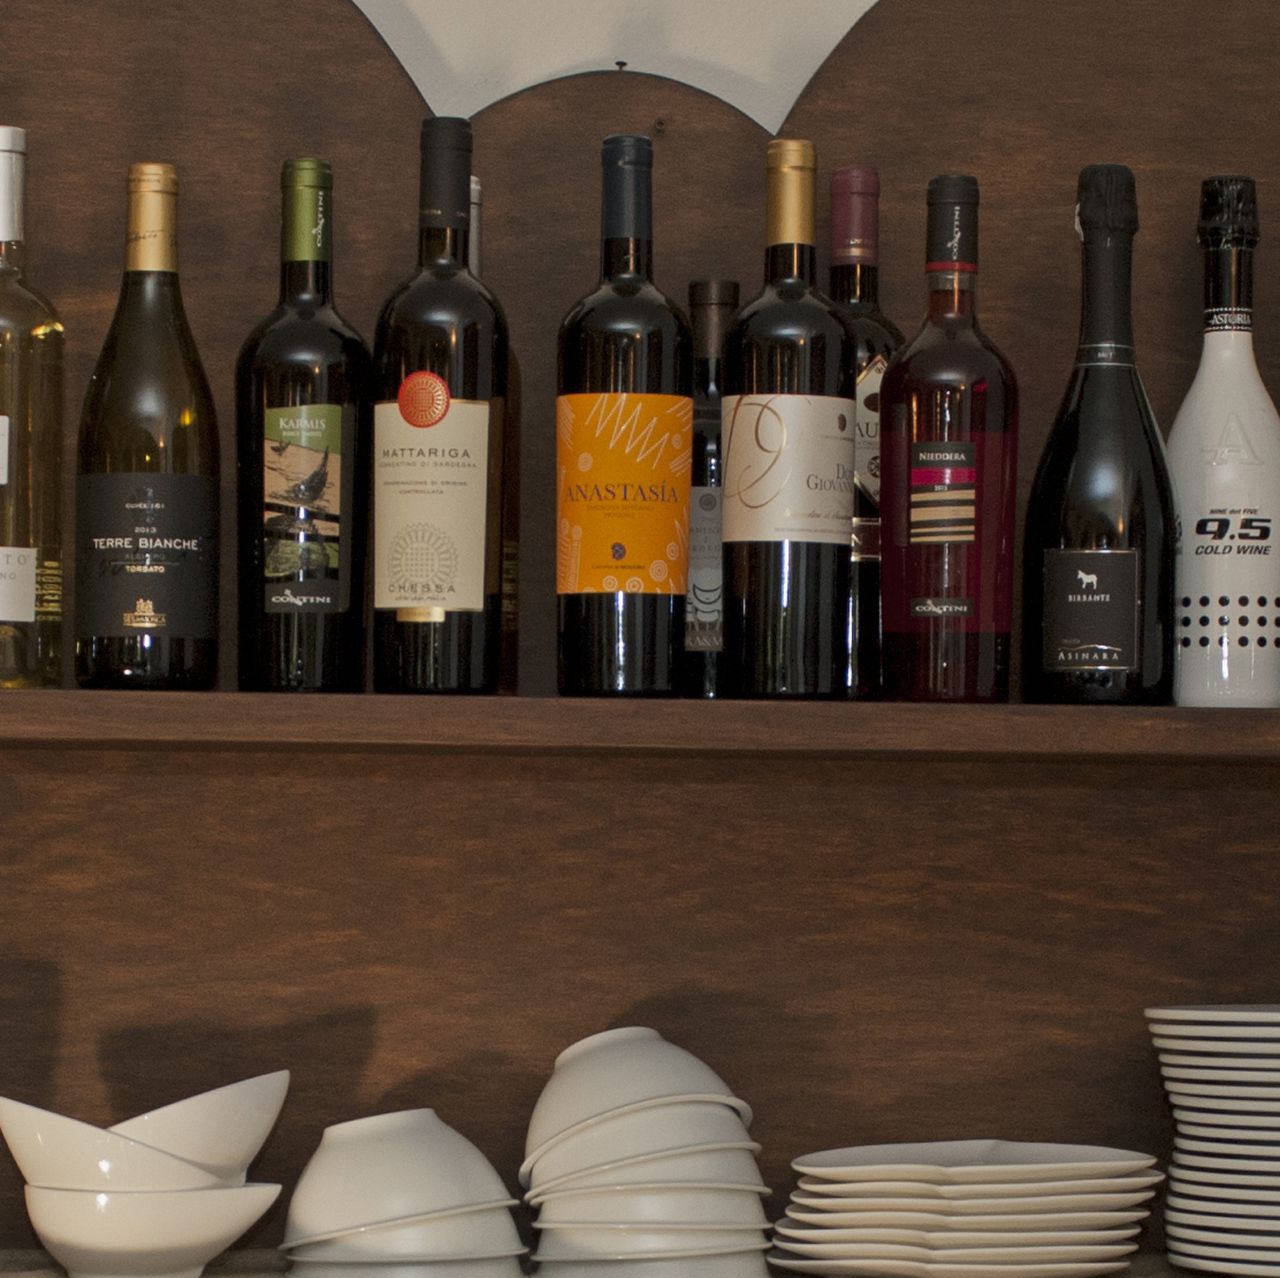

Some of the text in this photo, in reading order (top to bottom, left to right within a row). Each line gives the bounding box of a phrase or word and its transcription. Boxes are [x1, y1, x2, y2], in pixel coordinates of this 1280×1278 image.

[1210, 313, 1251, 325] ASTORIA
[280, 417, 326, 430] KARMIS
[1196, 518, 1272, 540] 9.5
[93, 537, 198, 550] TERRE BIANCHE
[1195, 545, 1272, 555] COLD WINE
[1058, 651, 1119, 661] ASINARA
